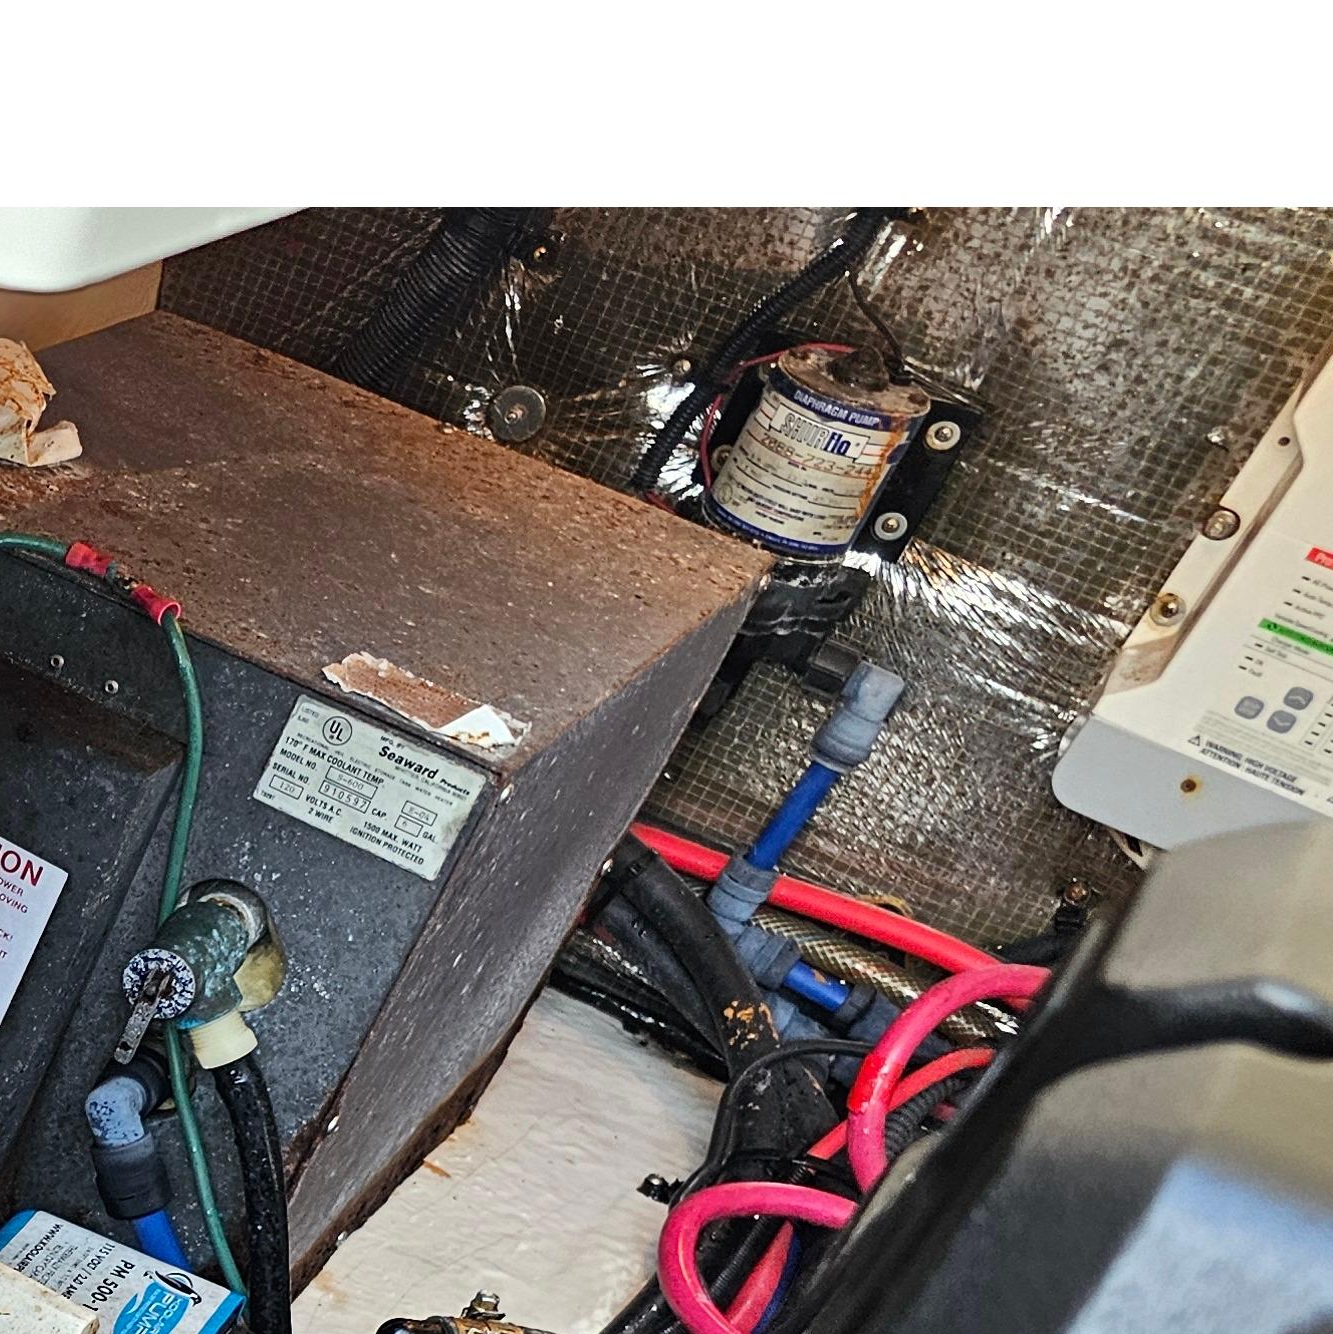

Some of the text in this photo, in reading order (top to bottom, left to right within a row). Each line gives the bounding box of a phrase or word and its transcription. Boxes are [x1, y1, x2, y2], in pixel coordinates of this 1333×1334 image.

[793, 390, 880, 427] DIAPHRAGM PUMP
[326, 719, 348, 742] UL
[279, 747, 305, 765] MODEL
[305, 759, 319, 771] NO.
[308, 746, 326, 760] MAX
[326, 755, 361, 776] COOLANT
[362, 771, 386, 787] TEMP.
[377, 744, 470, 795] Seaward Products
[1244, 756, 1264, 769] HIGH
[1263, 764, 1297, 783] VOLTAGE
[271, 762, 297, 778] SERIAL
[297, 774, 311, 785] NO.
[1244, 766, 1270, 781] HAUTE
[1271, 777, 1305, 796] TENSION
[279, 781, 295, 793] 120
[304, 794, 328, 809] VOLTS
[415, 786, 431, 796] WATER
[434, 795, 453, 806] HEATER
[314, 810, 333, 823] WIRE
[349, 826, 424, 865] IGNITION PROTECTED
[362, 820, 422, 853] 1500 MAX. WATT
[98, 1242, 115, 1255] 115
[108, 1258, 135, 1279] PM
[147, 1296, 184, 1334] KOOLAIR
